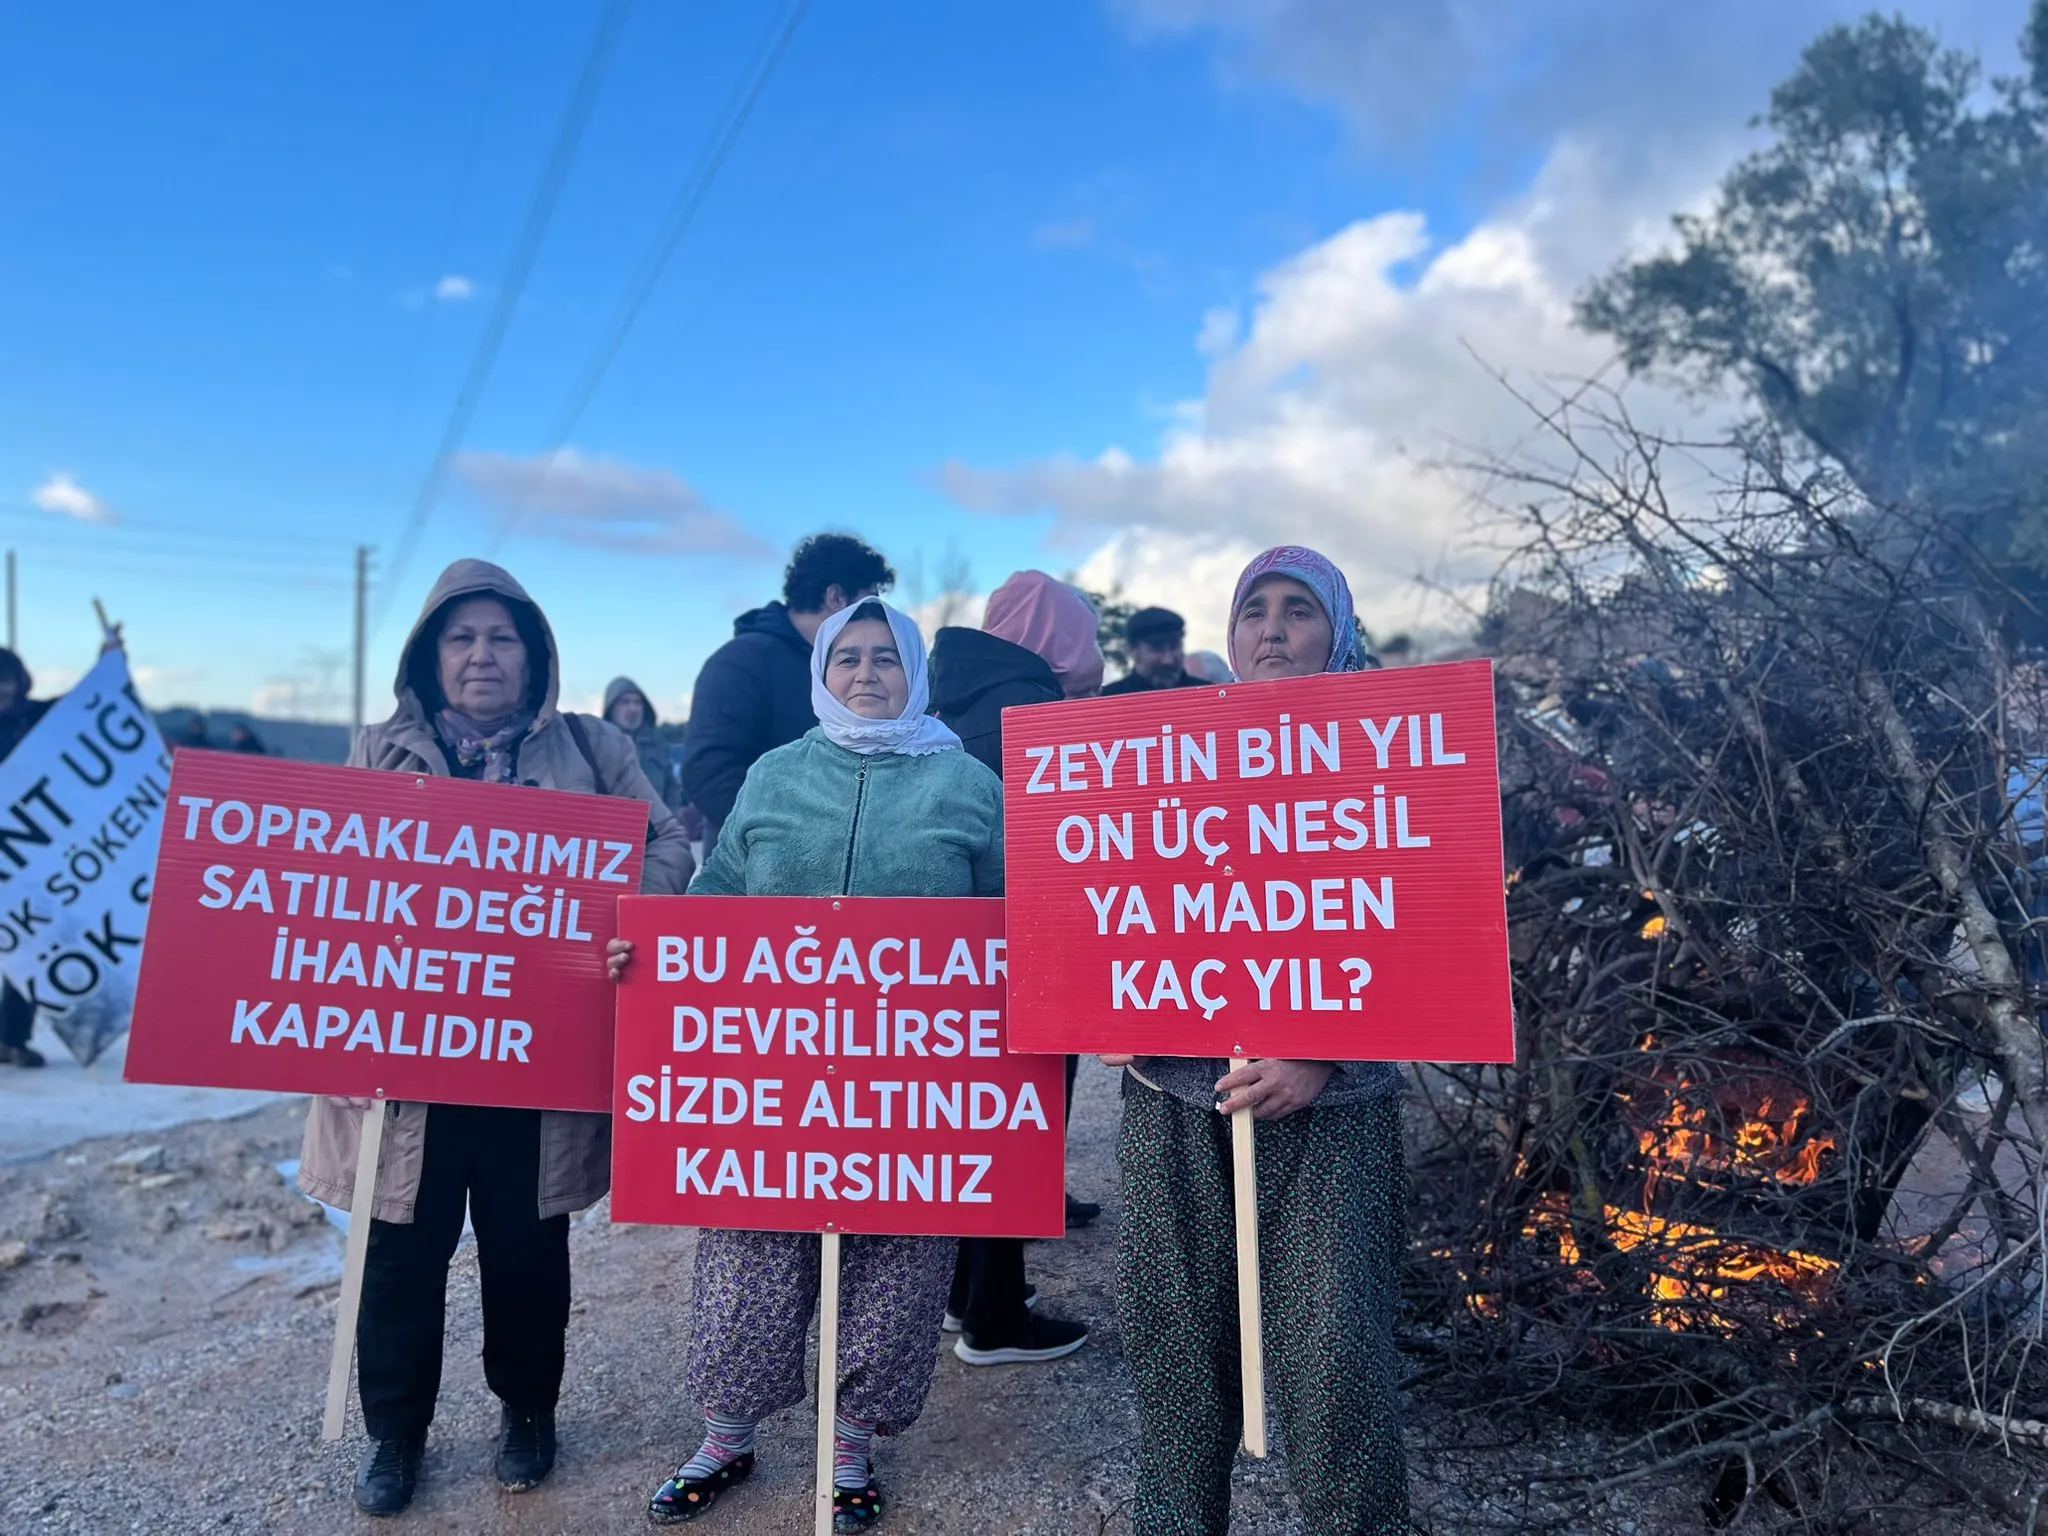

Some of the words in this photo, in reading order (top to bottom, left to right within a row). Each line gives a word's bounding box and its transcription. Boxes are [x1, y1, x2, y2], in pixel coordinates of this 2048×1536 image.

[1025, 724, 1218, 794] ZEYTİN
[1237, 714, 1341, 779] BİN
[1359, 712, 1466, 769] YIL
[0, 774, 74, 882] NT
[178, 795, 633, 883] TOPRAKLARIMIZ
[1056, 812, 1134, 863] ON
[1152, 797, 1230, 867] ÜÇ
[1248, 784, 1431, 855] NESİL
[198, 864, 422, 926] SATILIK
[435, 884, 593, 942] DEĞİL
[1083, 885, 1157, 935] YA
[1173, 876, 1395, 934] MADEN
[270, 926, 516, 998] İHANETE
[657, 936, 727, 983] BU
[1111, 958, 1228, 1021] KAÇ
[1242, 957, 1373, 1012] YIL?
[230, 999, 533, 1063] KAPALIDIR
[673, 997, 1001, 1058] DEVRİLİRSE
[625, 1065, 783, 1127] SİZDE
[799, 1080, 1049, 1130] ALTINDA
[674, 1146, 993, 1203] KALIRSINIZ
